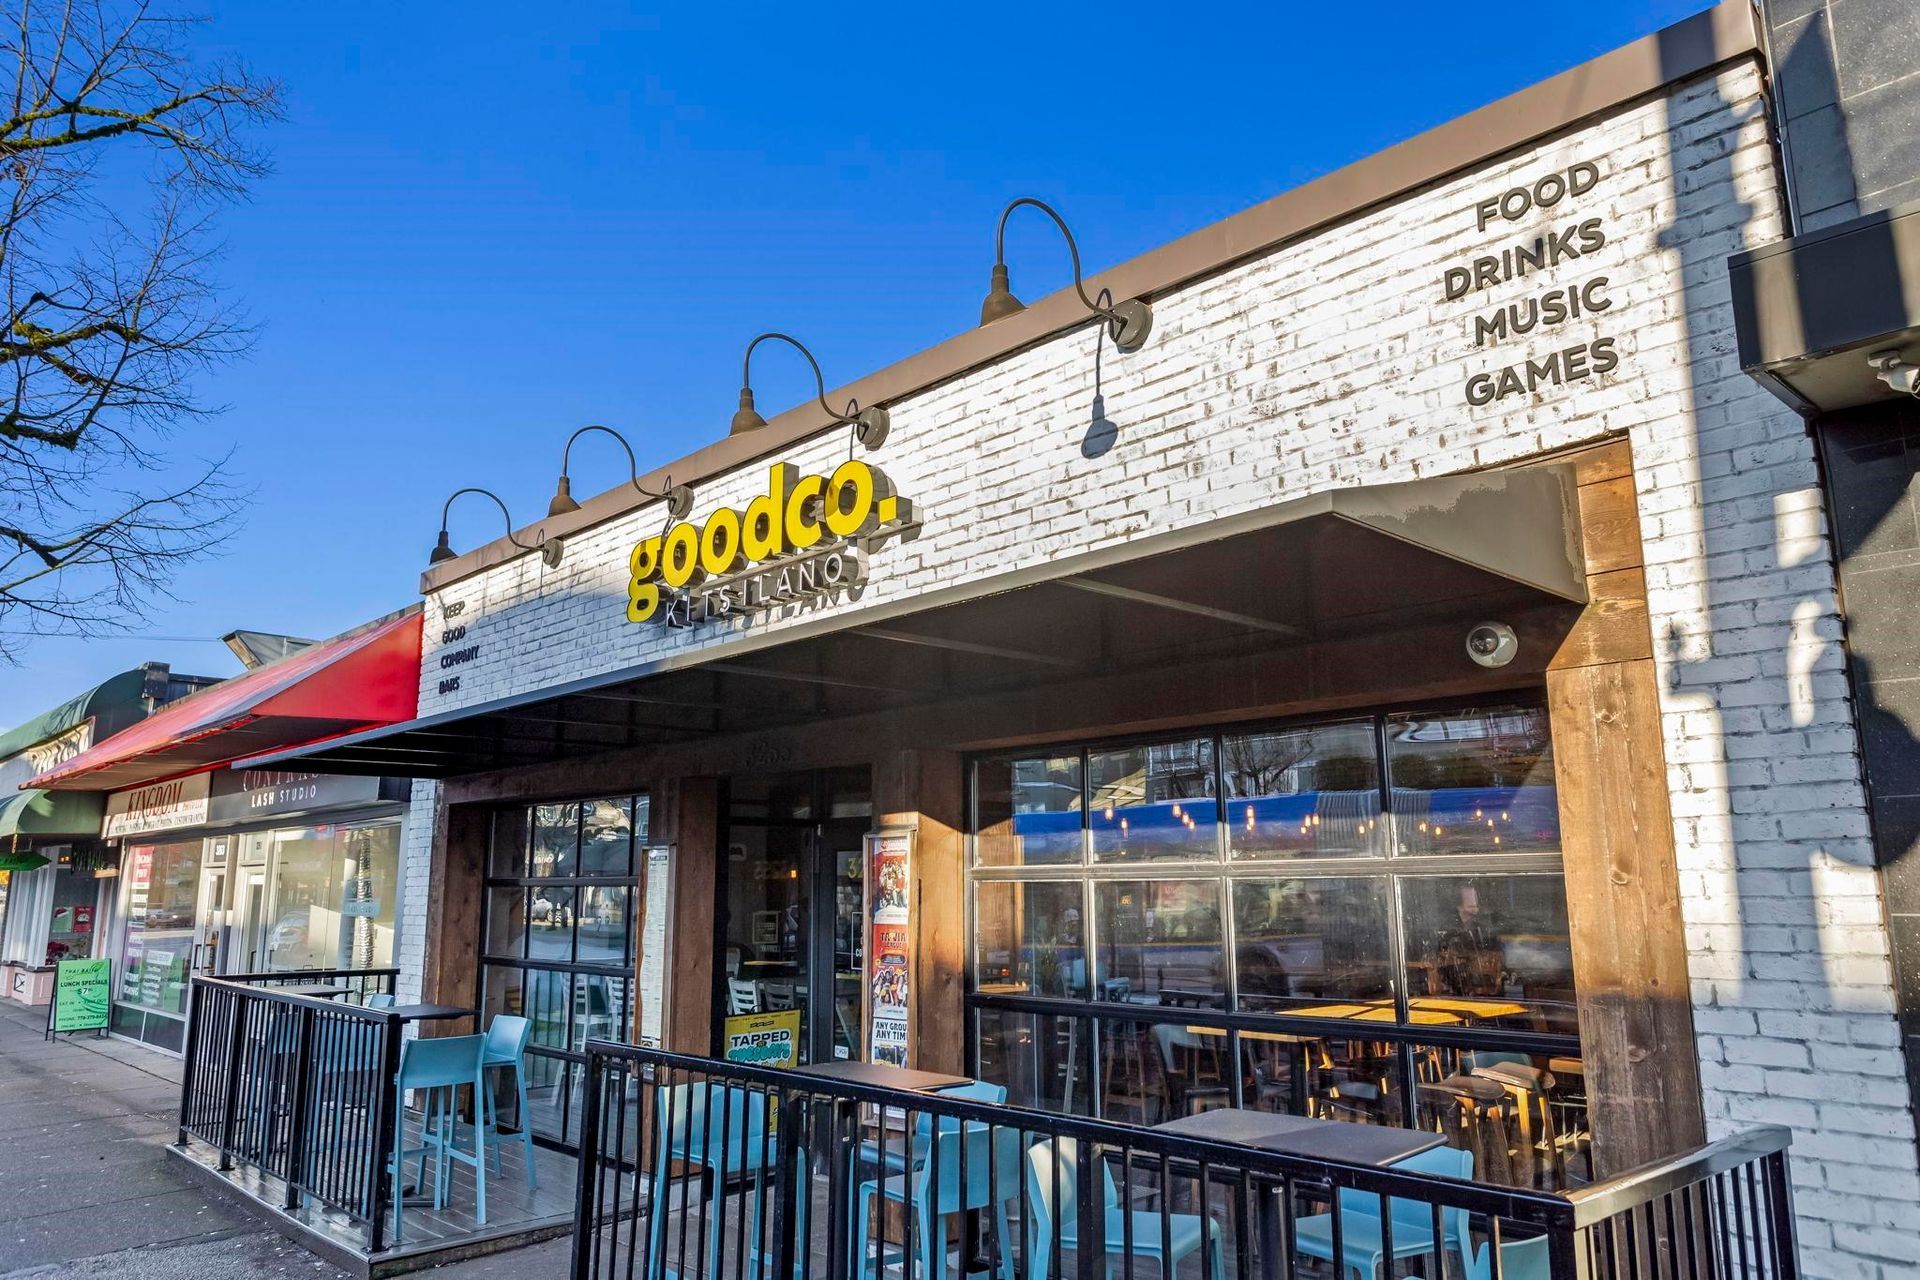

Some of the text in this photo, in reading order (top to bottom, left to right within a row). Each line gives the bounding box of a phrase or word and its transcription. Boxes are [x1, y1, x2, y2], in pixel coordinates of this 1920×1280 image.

[1476, 161, 1600, 232] FOOD
[1444, 217, 1606, 301] DRINKS
[1475, 276, 1613, 346] MUSIC
[1465, 337, 1619, 406] GAMES
[626, 459, 899, 623] goodco.
[666, 552, 844, 629] KITSILANO
[444, 601, 465, 619] KEEP
[442, 625, 466, 645] GOOD
[440, 644, 480, 670] COMPANY
[439, 676, 460, 694] BARS
[126, 781, 184, 821] KINGDOM
[251, 784, 317, 808] LASH STUDIO
[731, 1030, 790, 1047] TAPPED
[876, 1021, 907, 1032] ANY GROU
[876, 1030, 906, 1041] ANY TIM
